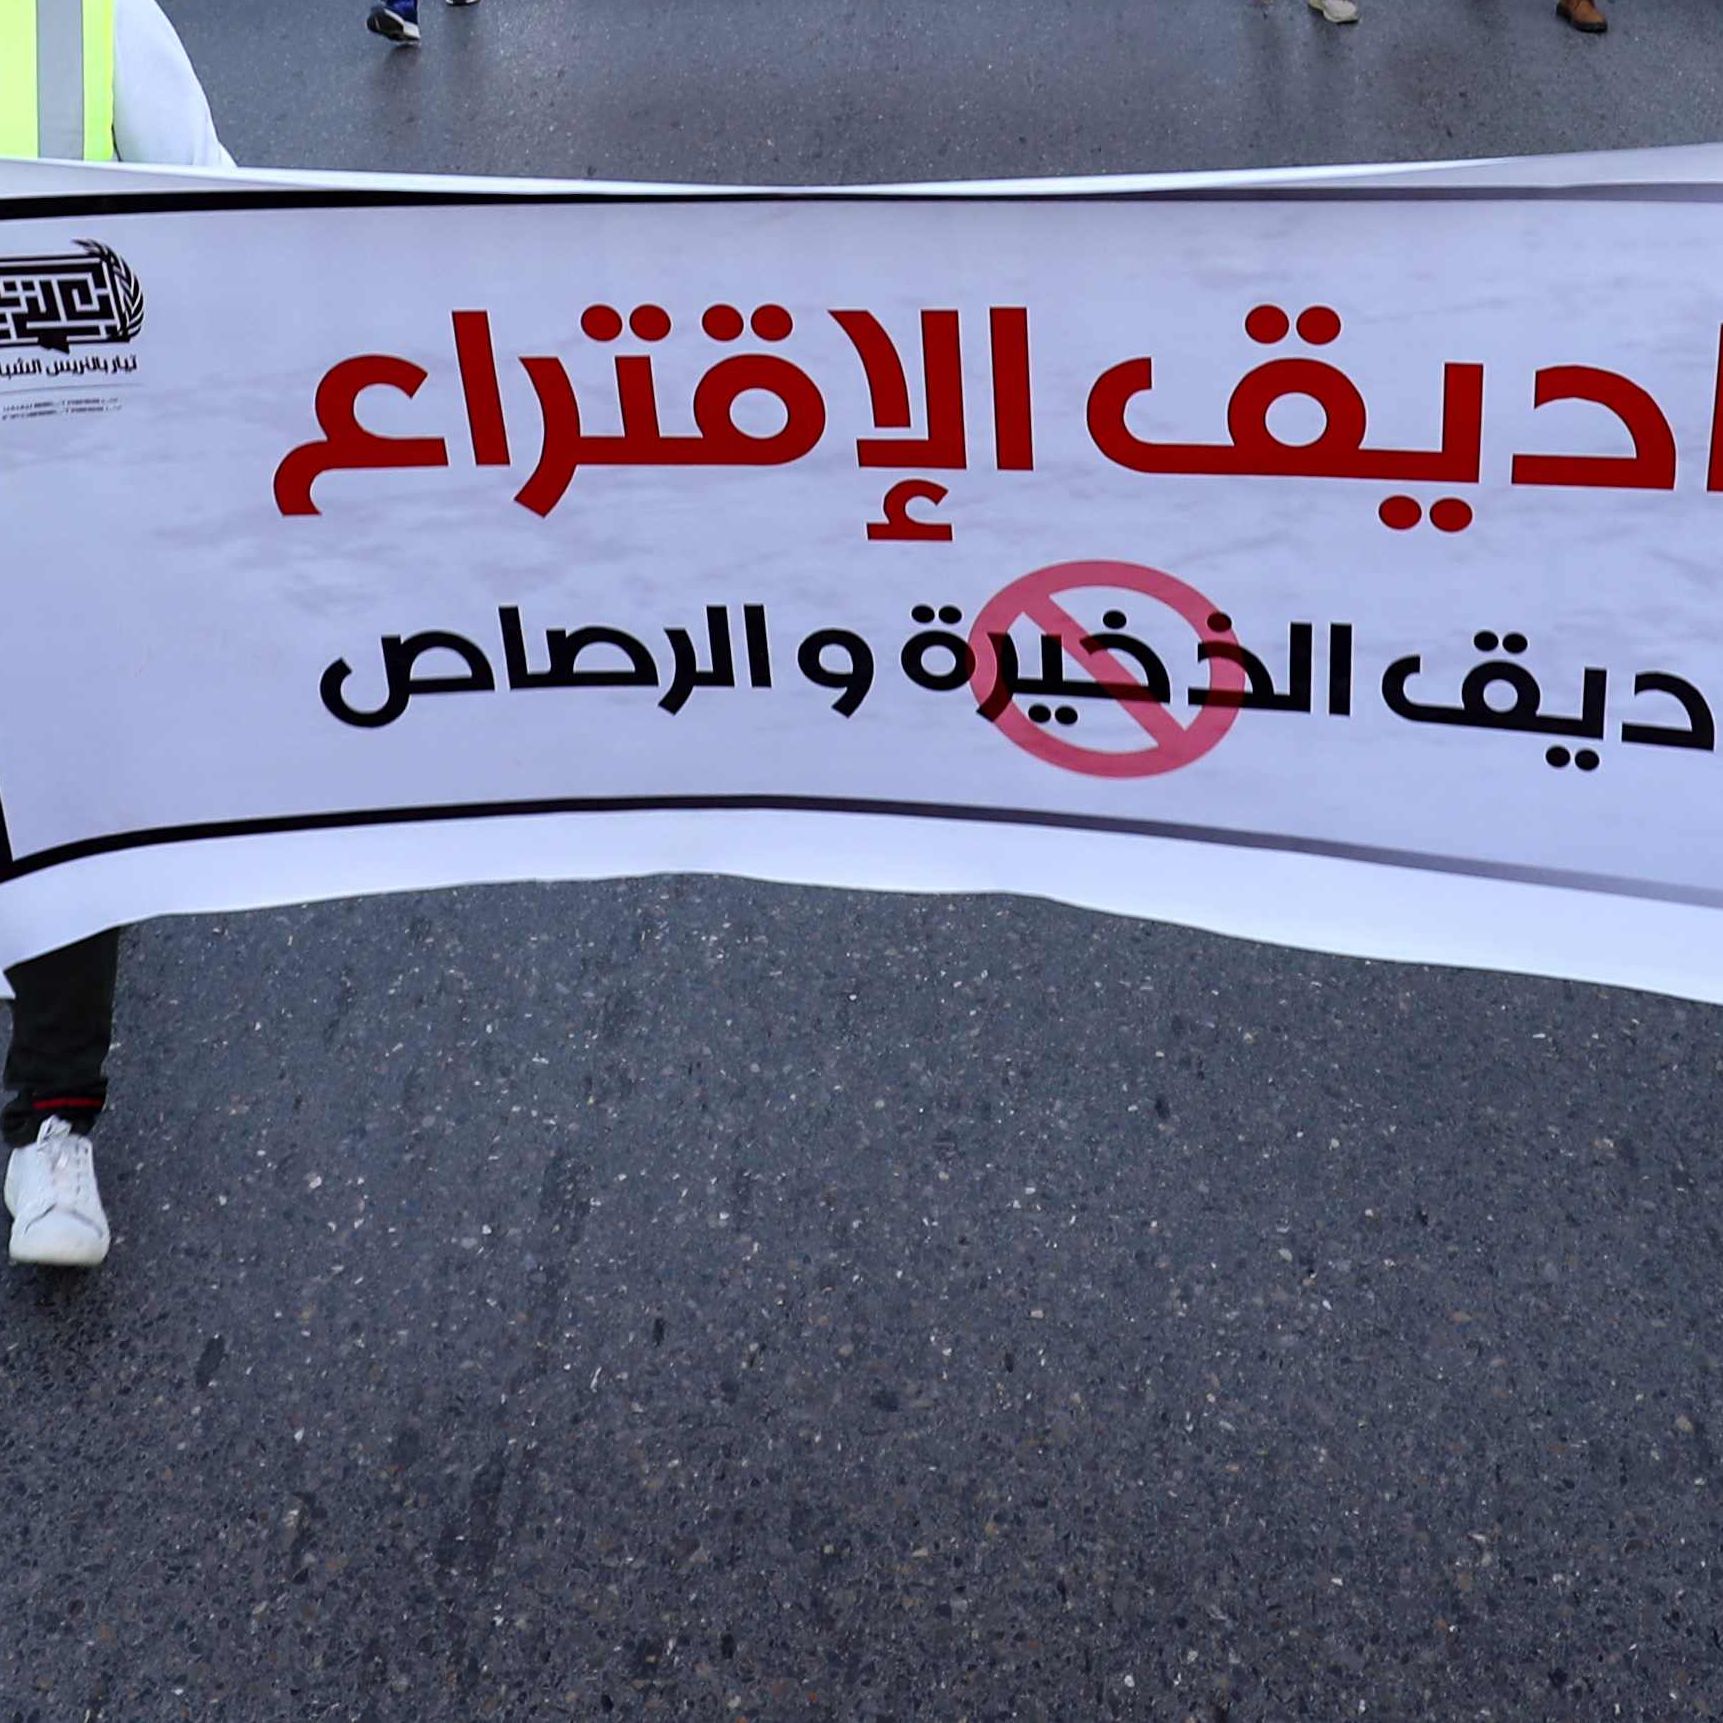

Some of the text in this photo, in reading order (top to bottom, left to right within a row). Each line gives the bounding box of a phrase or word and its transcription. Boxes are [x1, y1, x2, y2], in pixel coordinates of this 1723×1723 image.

[274, 303, 1034, 543] الإقتراع
[318, 603, 773, 730] الرصاص
[796, 627, 875, 720] و
[900, 604, 1354, 727] الذخيرة
